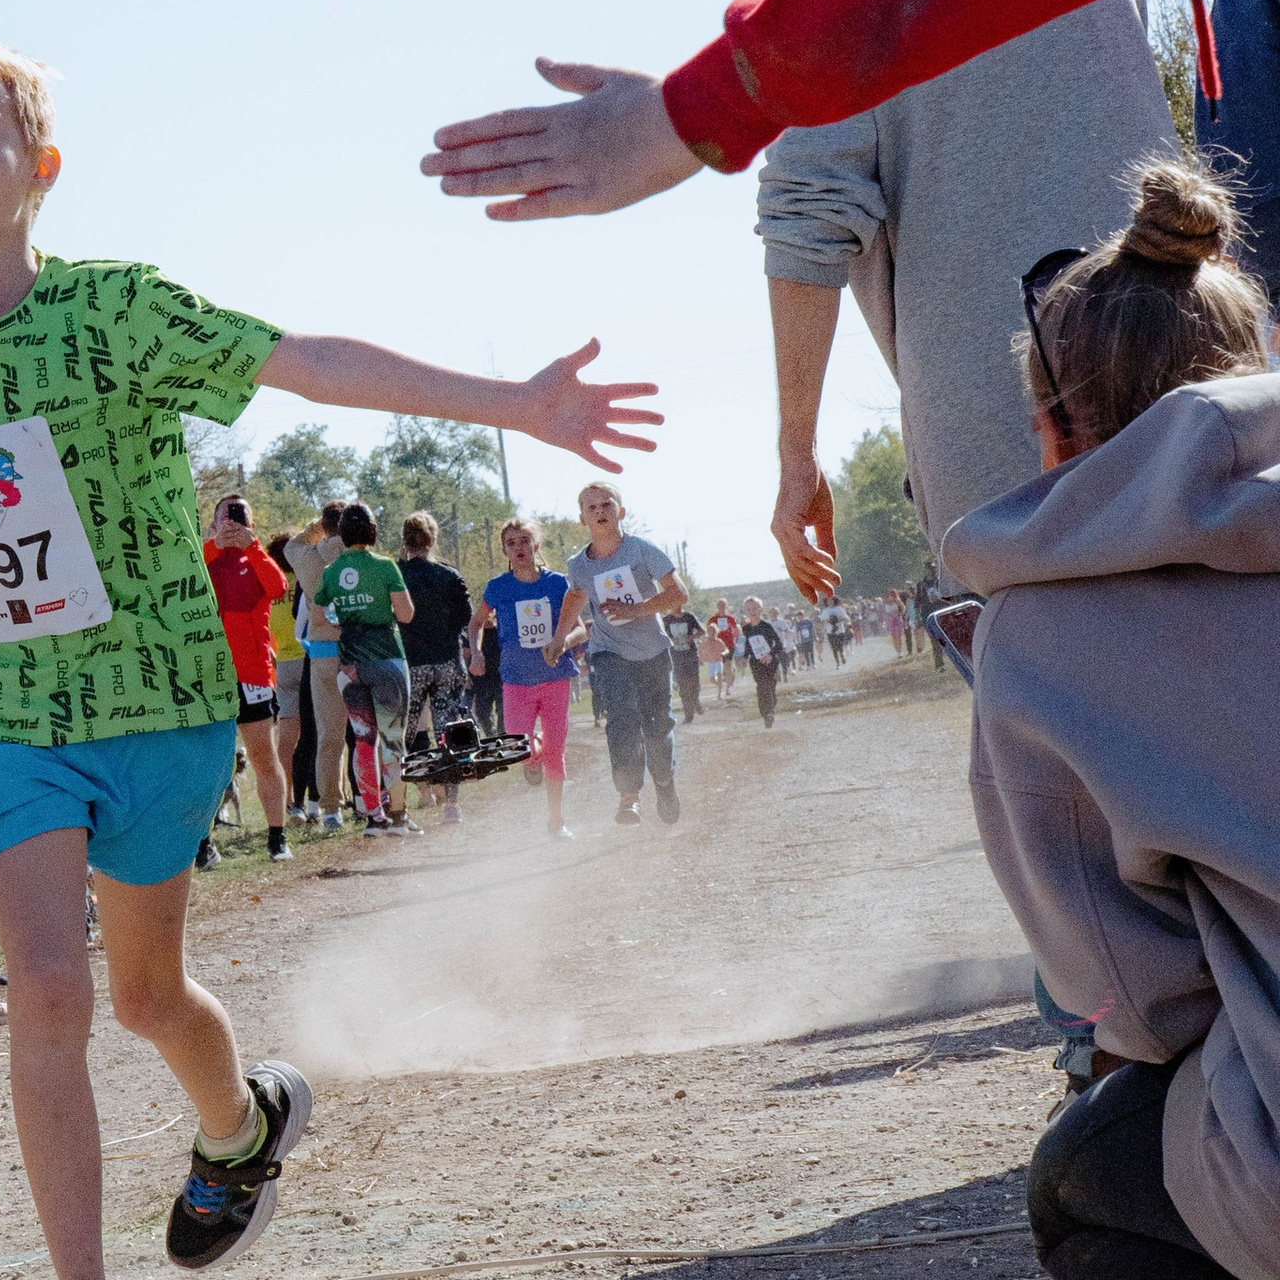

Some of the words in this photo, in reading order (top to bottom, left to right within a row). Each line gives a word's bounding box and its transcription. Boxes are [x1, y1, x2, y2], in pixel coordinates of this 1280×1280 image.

[12, 333, 48, 349] FILA
[167, 315, 219, 344] FILA
[61, 334, 83, 381] FILA
[84, 324, 118, 395] FILA
[138, 334, 163, 372] FILA
[0, 363, 21, 415] FILA
[153, 376, 206, 389] FILA
[33, 396, 71, 416] FILA
[105, 429, 119, 466] FILA
[150, 432, 187, 460] ILA
[85, 478, 109, 527] FILA
[118, 515, 148, 581] FILA
[184, 628, 215, 646] FILA
[521, 623, 546, 637] 300
[19, 644, 37, 689] FILA
[135, 645, 161, 691] FILA
[78, 672, 98, 720] FILA
[109, 704, 147, 720] FILA
